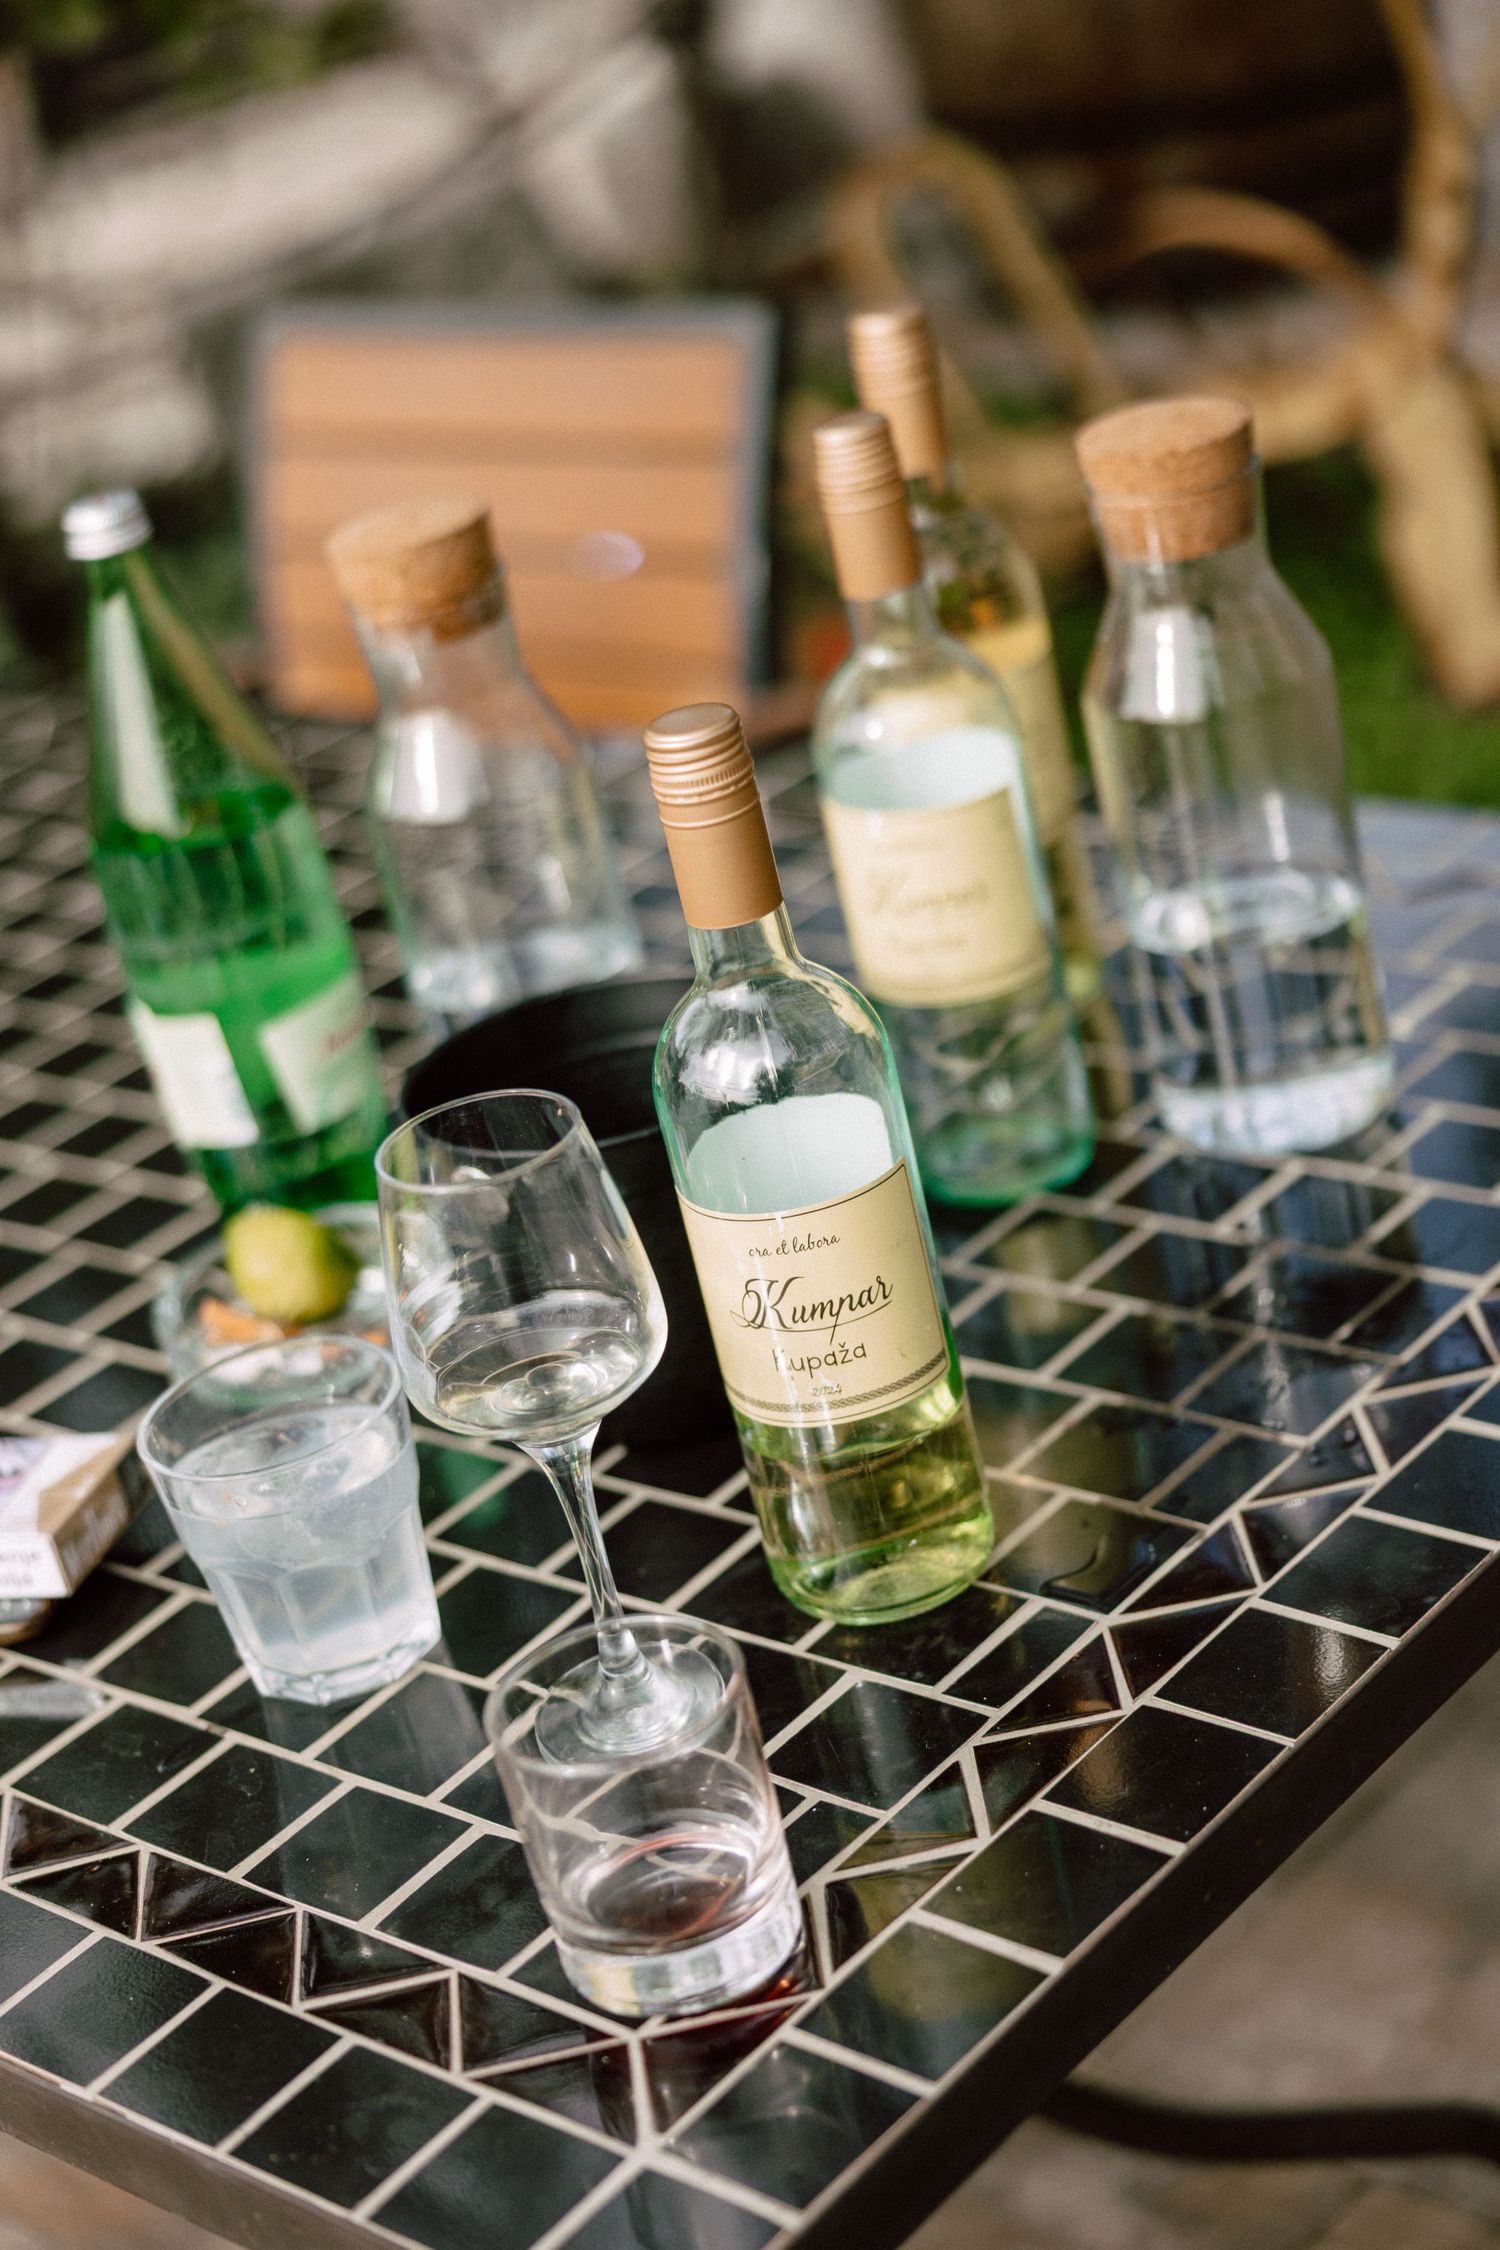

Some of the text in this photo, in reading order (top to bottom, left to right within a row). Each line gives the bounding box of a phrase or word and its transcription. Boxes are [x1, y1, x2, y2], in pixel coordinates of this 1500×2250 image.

[748, 1232, 840, 1257] ora et labora
[730, 1275, 894, 1346] Kumpar
